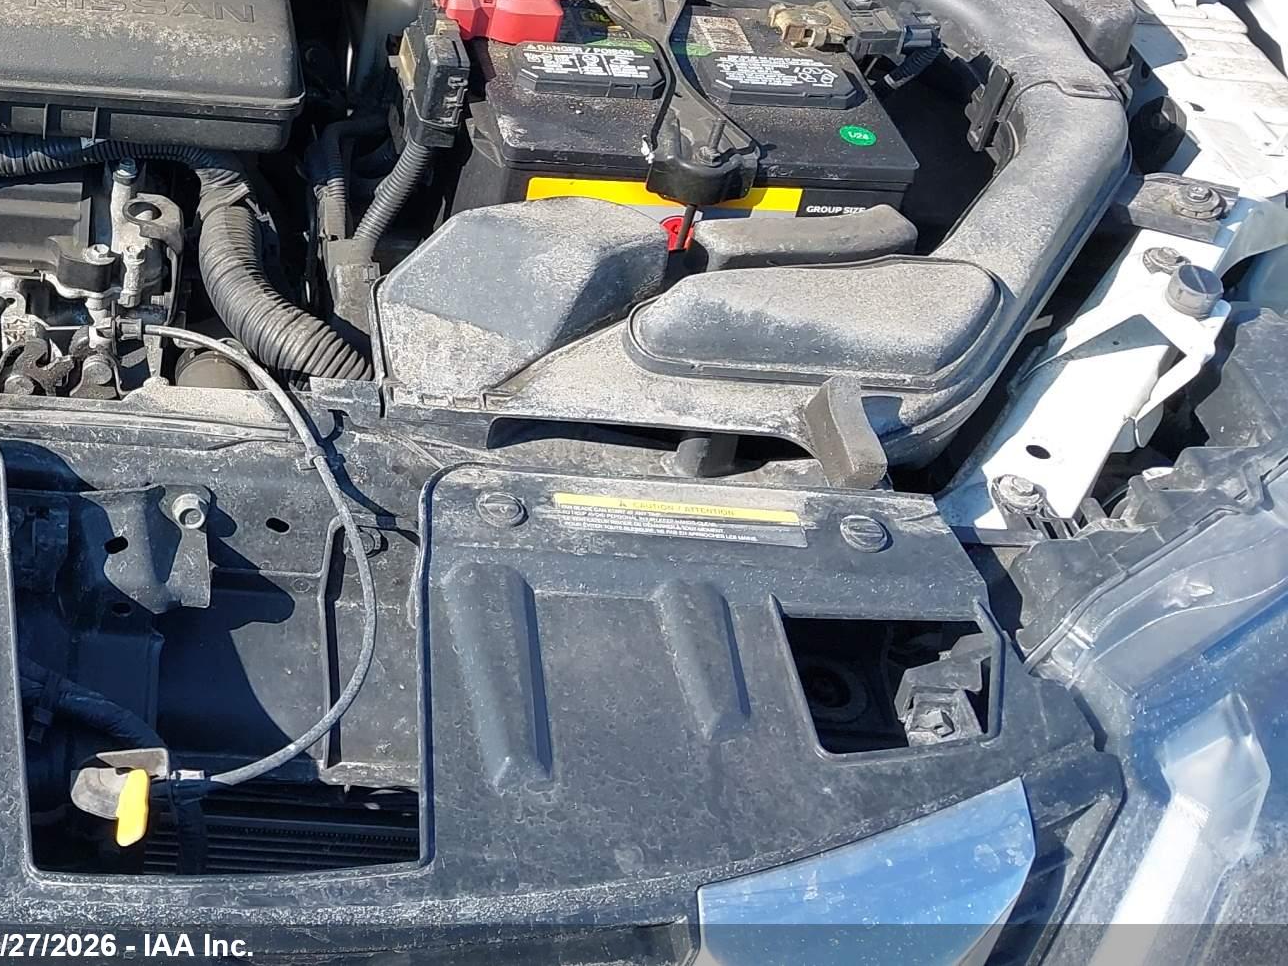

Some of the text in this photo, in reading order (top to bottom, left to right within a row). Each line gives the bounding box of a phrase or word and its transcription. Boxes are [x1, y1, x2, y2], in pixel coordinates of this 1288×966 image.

[537, 44, 583, 53] DANGER
[806, 206, 843, 214] GROUP
[632, 502, 676, 512] CAUTION
[684, 506, 736, 516] ATTENTION
